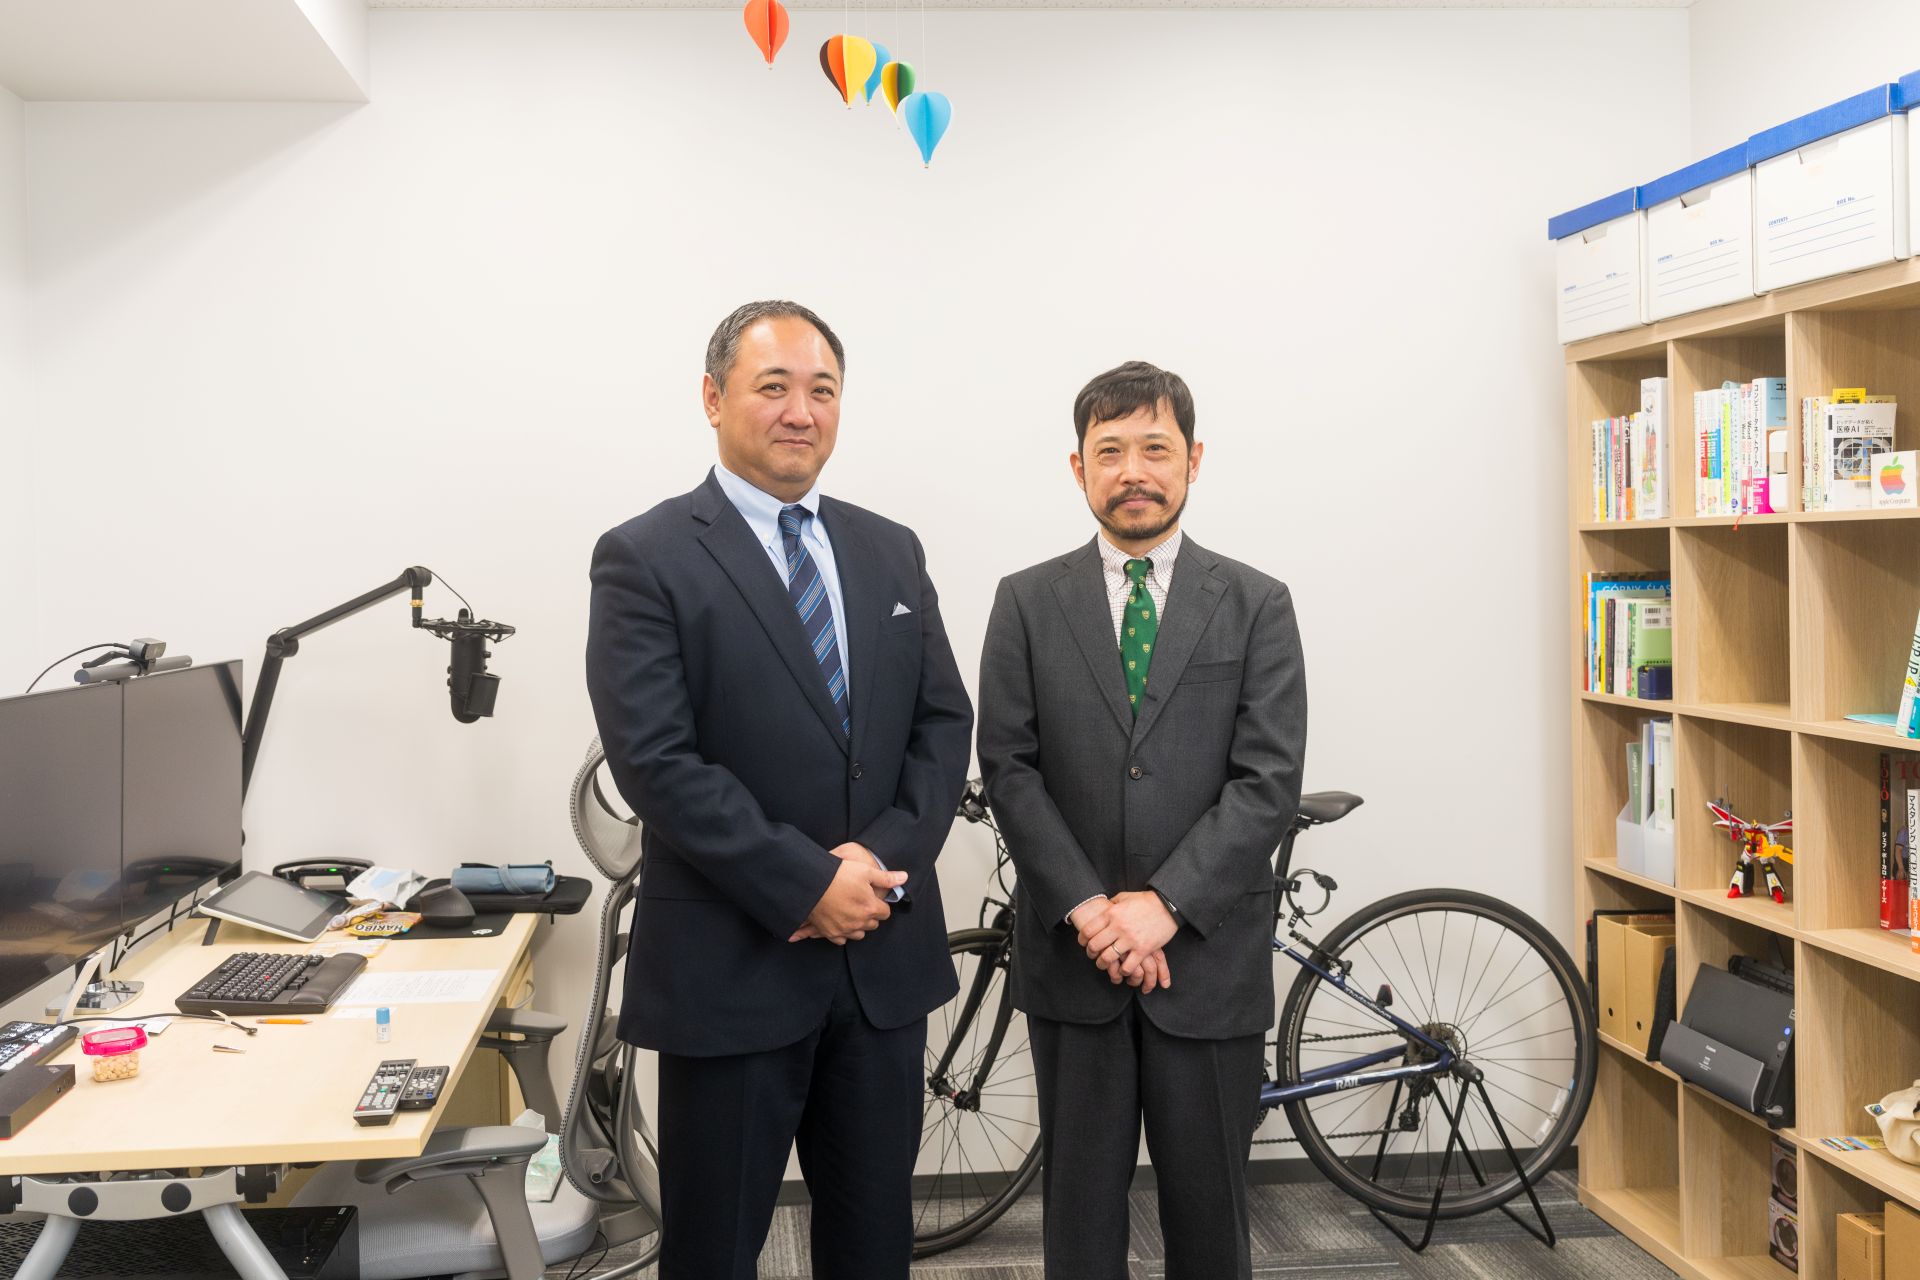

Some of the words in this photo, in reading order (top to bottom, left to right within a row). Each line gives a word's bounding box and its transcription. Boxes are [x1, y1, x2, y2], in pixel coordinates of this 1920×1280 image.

[1768, 216, 1788, 227] CONTENTS
[1836, 425, 1860, 434] 医療AI
[355, 923, 404, 932] HARIBO
